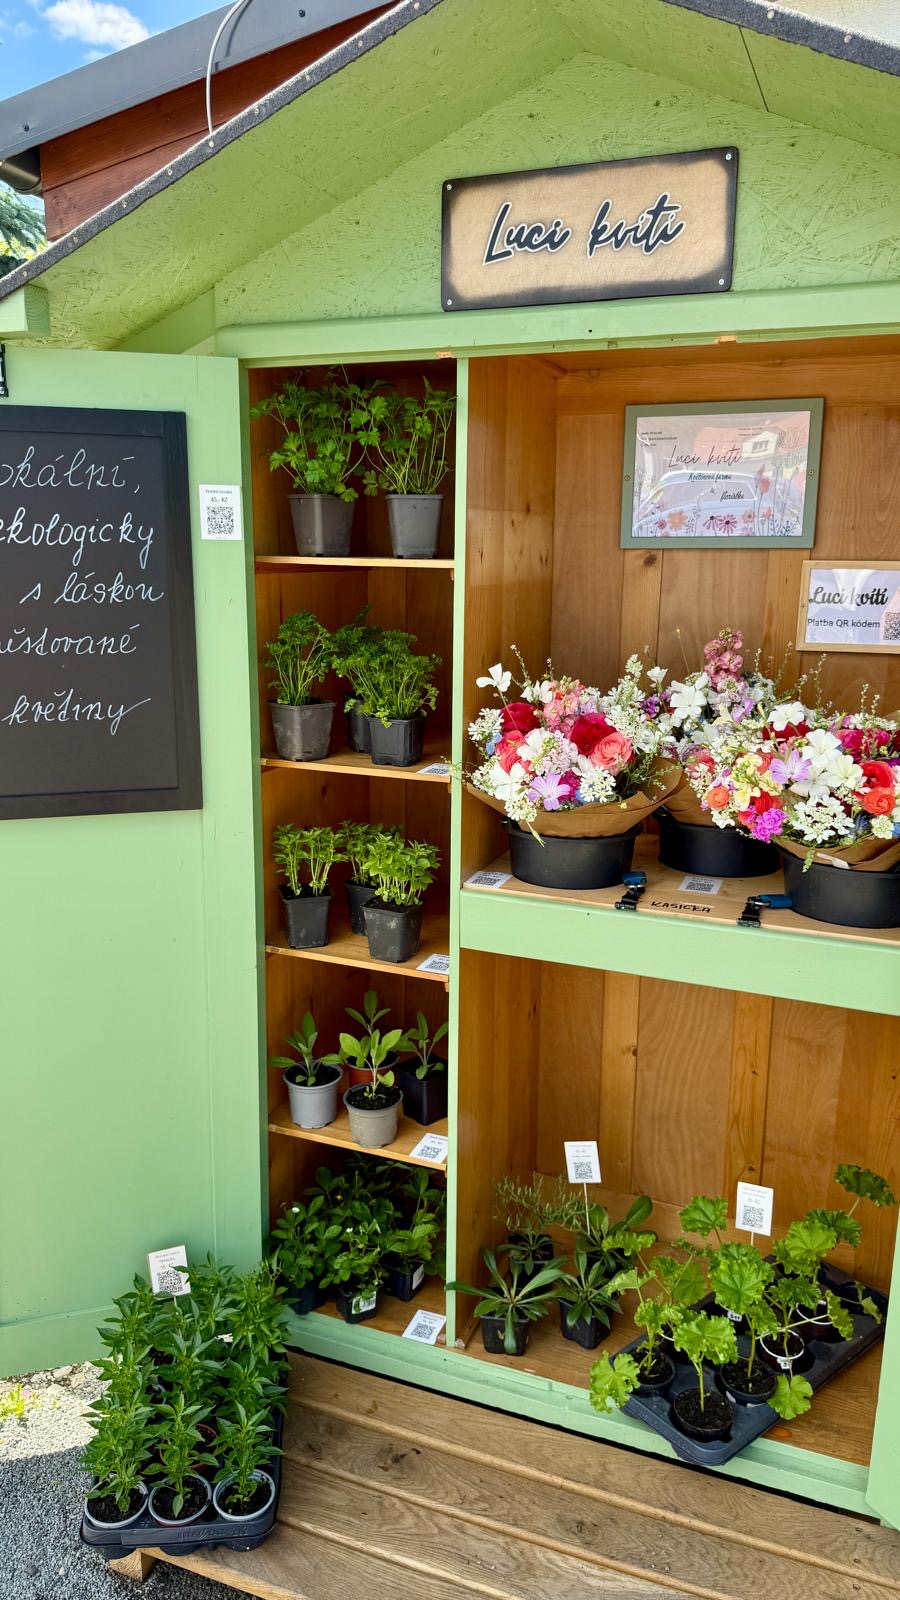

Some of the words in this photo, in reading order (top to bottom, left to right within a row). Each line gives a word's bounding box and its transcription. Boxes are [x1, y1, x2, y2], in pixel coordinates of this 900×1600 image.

[483, 202, 571, 265] Luci
[668, 444, 700, 468] Luci
[19, 582, 41, 604] s
[54, 571, 164, 604] láskou
[808, 586, 847, 605] Luci
[850, 587, 889, 606] kvítí
[807, 618, 834, 627] Platba
[836, 619, 849, 628] QR
[851, 619, 881, 628] kódem
[0, 623, 140, 656] ěstované
